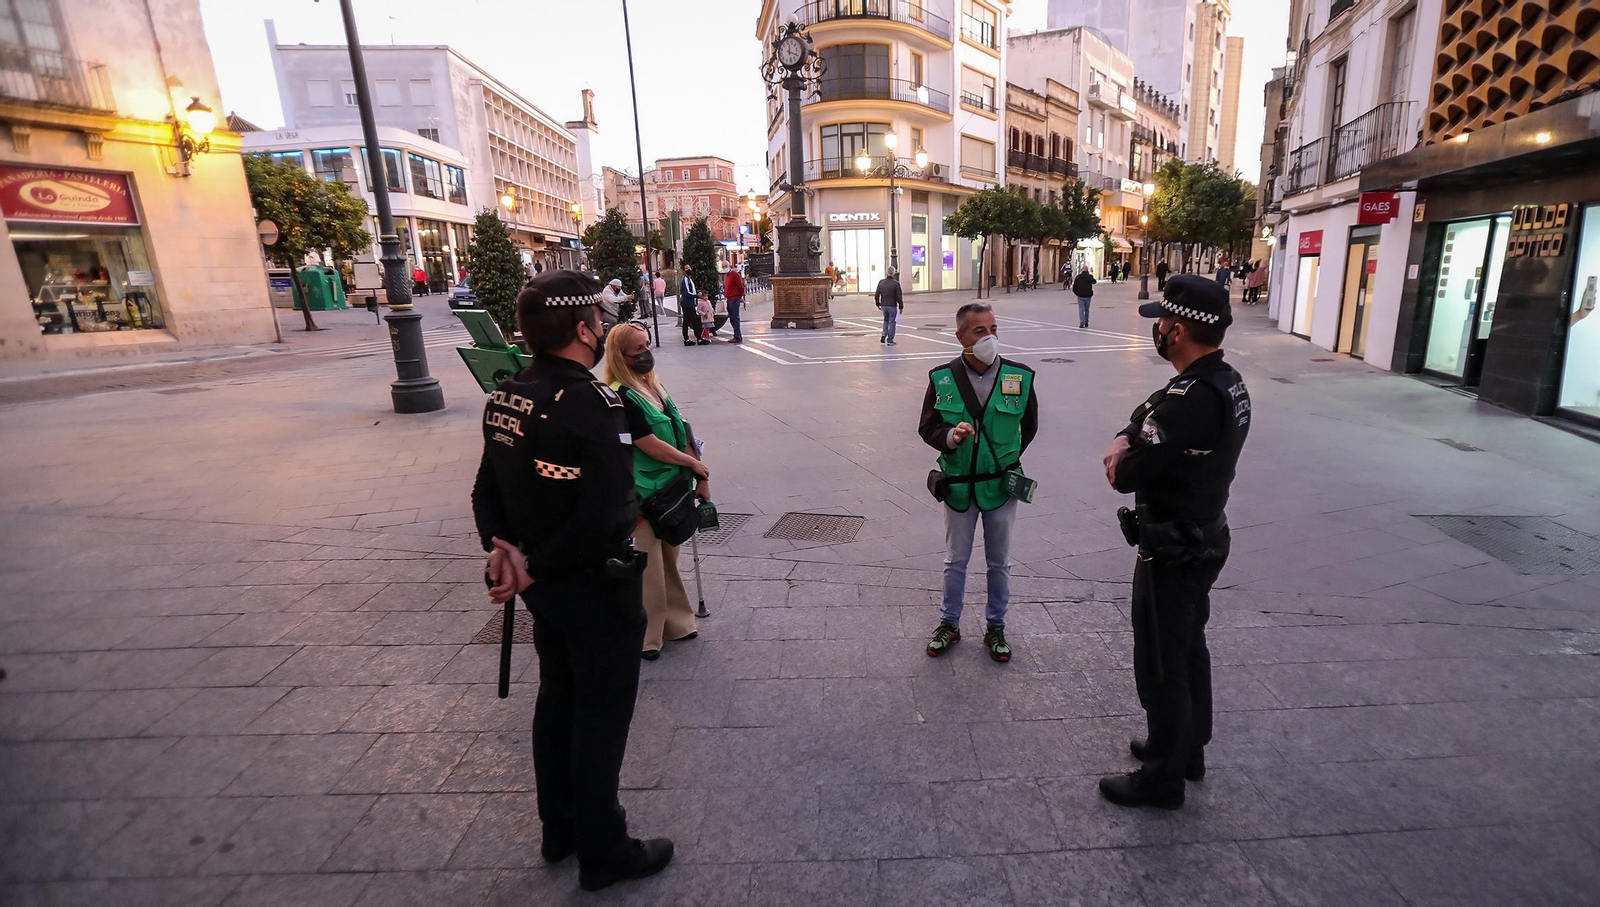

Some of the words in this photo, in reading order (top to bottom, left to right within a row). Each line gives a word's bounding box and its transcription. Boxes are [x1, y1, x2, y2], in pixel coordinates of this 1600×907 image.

[275, 132, 283, 140] LA
[284, 131, 299, 139] VEGA
[64, 172, 126, 196] PASTELERIA
[38, 192, 54, 200] La
[59, 194, 98, 203] Guinda
[1363, 202, 1391, 212] GAES
[829, 212, 881, 222] DENTIX
[1512, 203, 1568, 231] ULLOA
[488, 390, 535, 416] POLICIA
[486, 410, 525, 437] LOCAL
[492, 432, 514, 447] JEREZ
